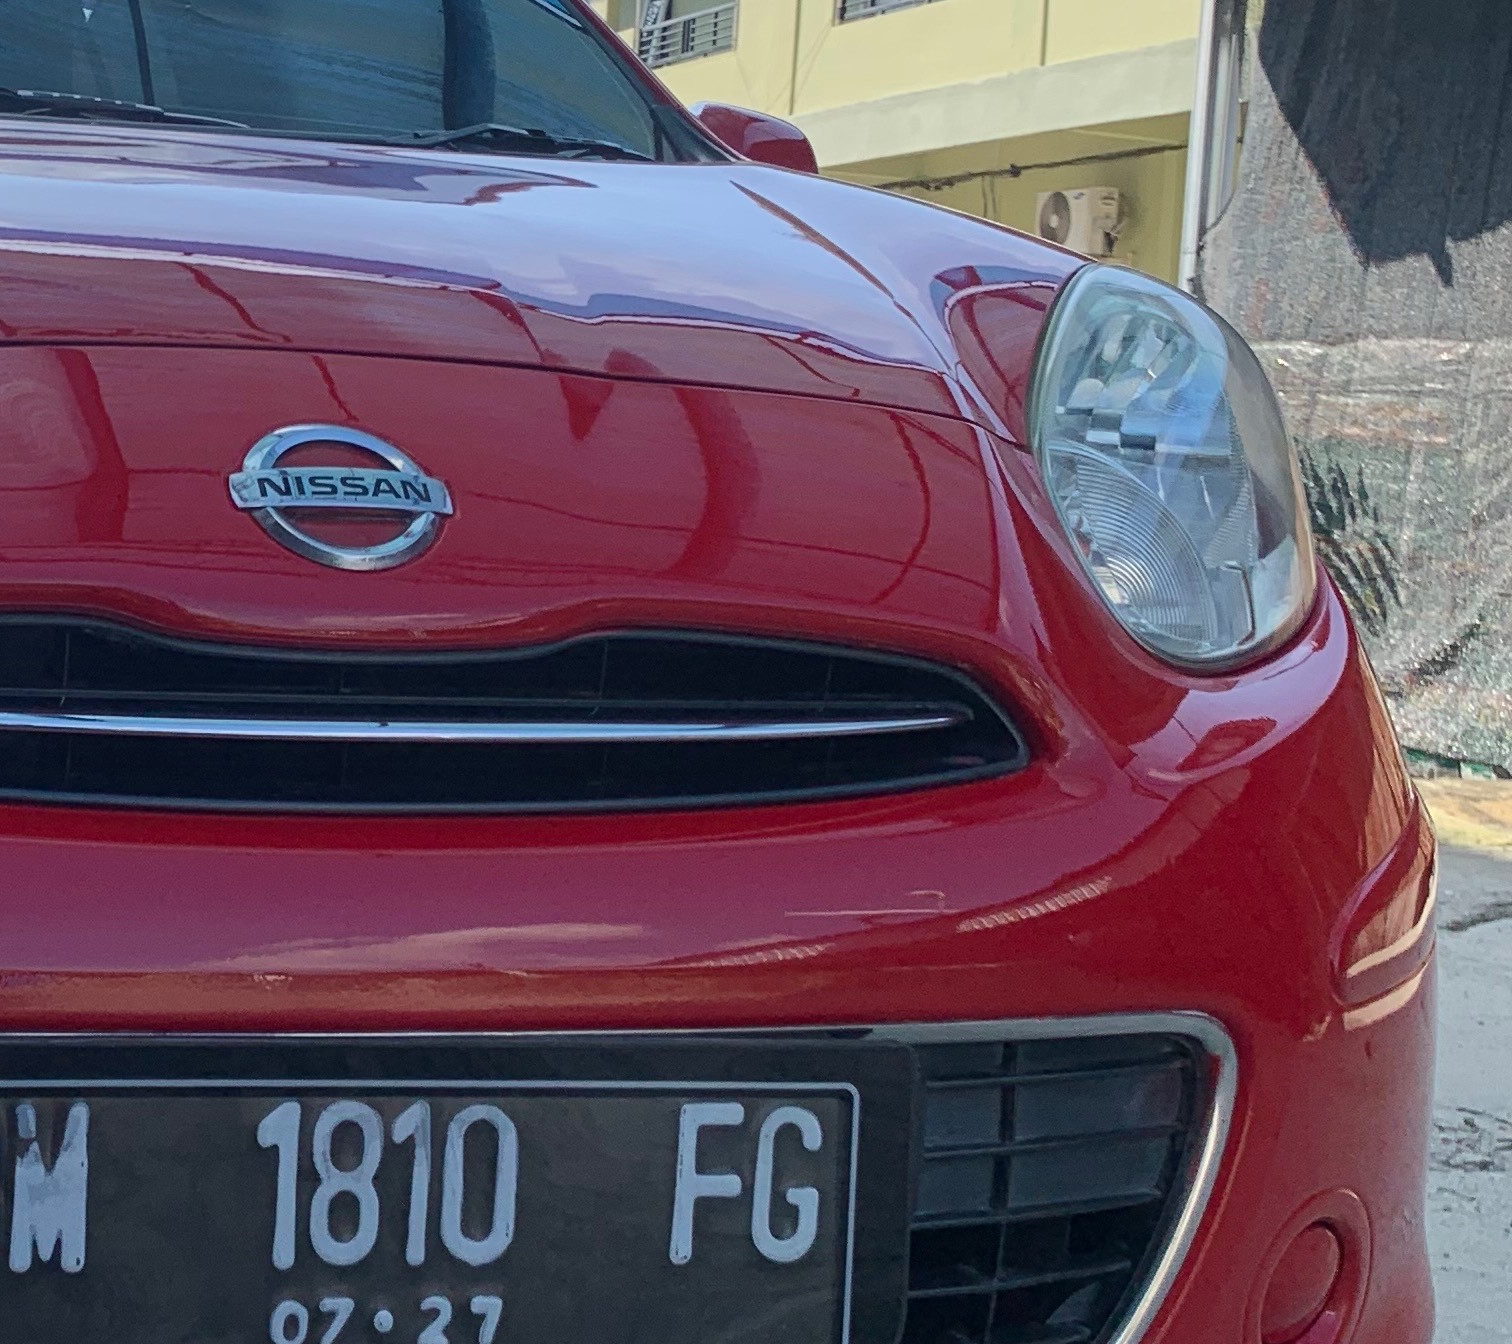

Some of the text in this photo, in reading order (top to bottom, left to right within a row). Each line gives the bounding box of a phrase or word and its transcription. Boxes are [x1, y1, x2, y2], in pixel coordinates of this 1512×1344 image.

[256, 474, 432, 504] NISSAN
[256, 1099, 520, 1271] 1810
[669, 1102, 824, 1266] FG
